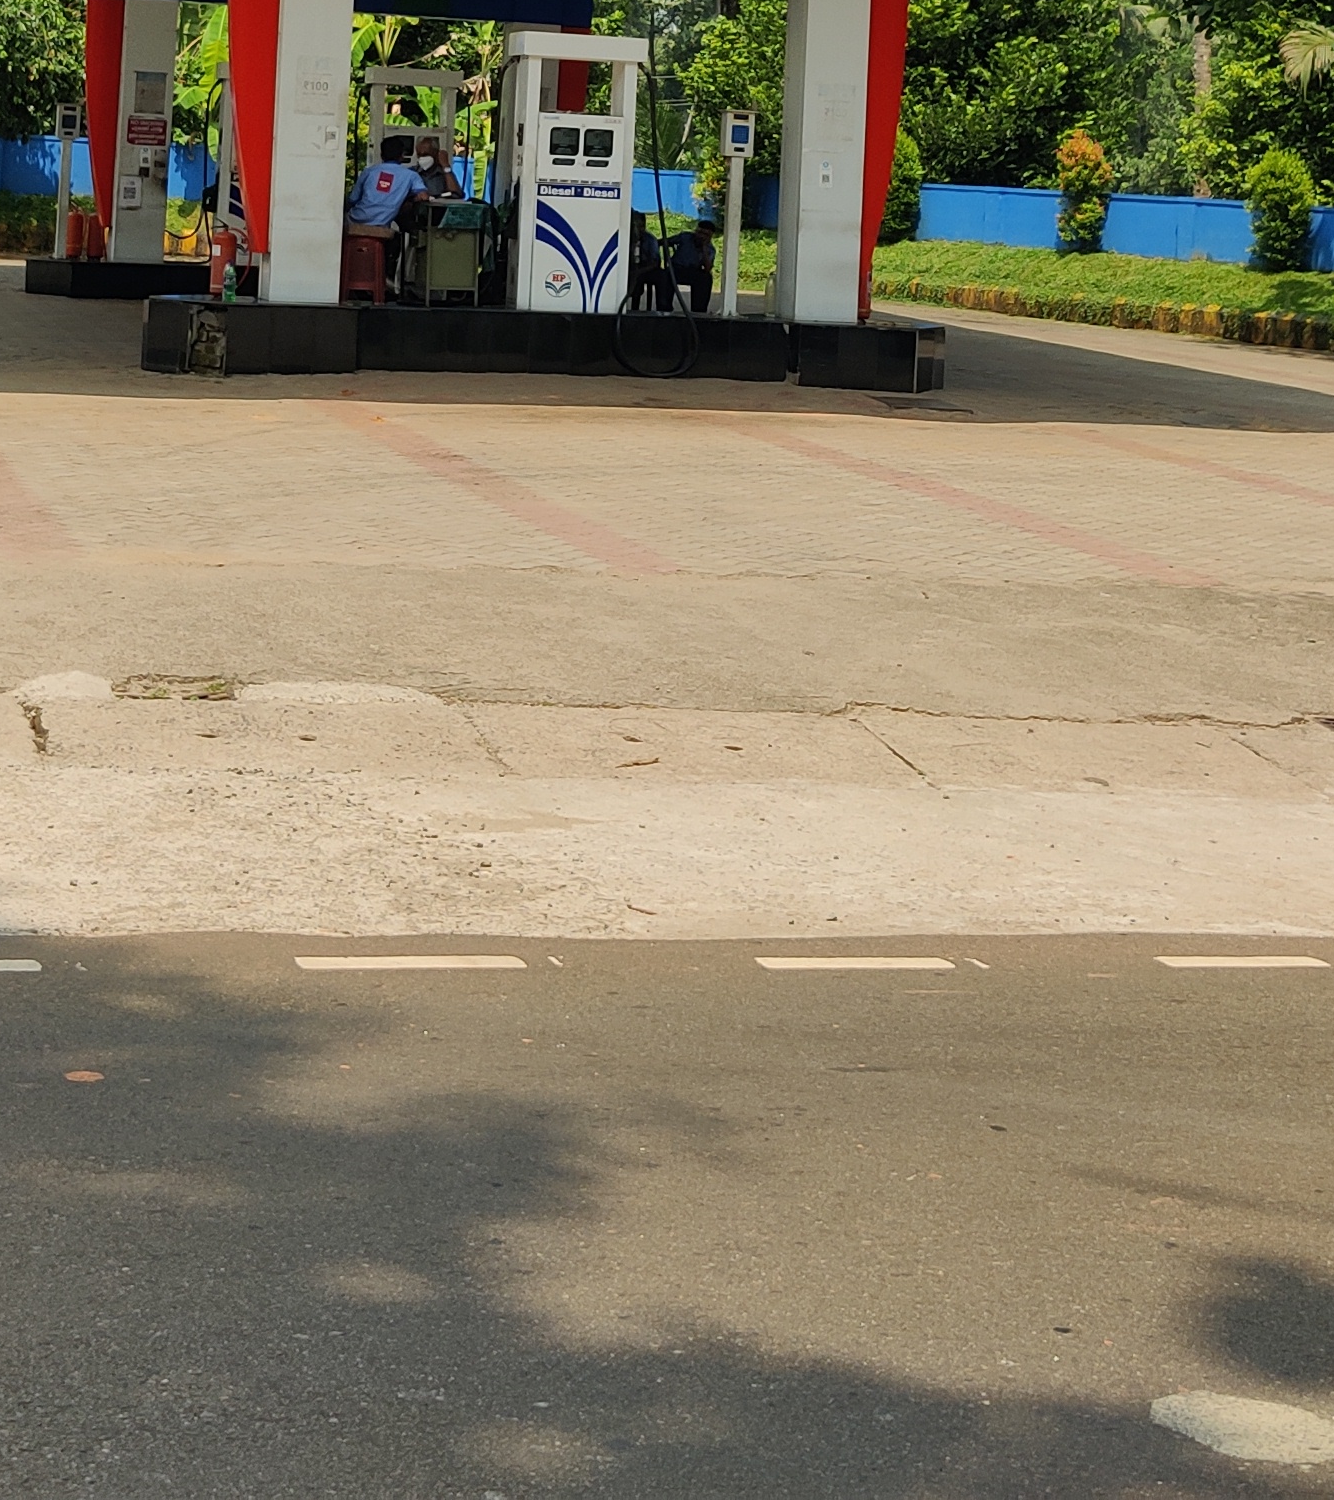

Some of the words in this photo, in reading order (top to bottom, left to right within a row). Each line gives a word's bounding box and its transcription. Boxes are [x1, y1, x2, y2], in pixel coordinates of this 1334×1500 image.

[539, 185, 575, 196] Diesel
[583, 187, 618, 198] Diesel
[552, 274, 566, 282] HP
